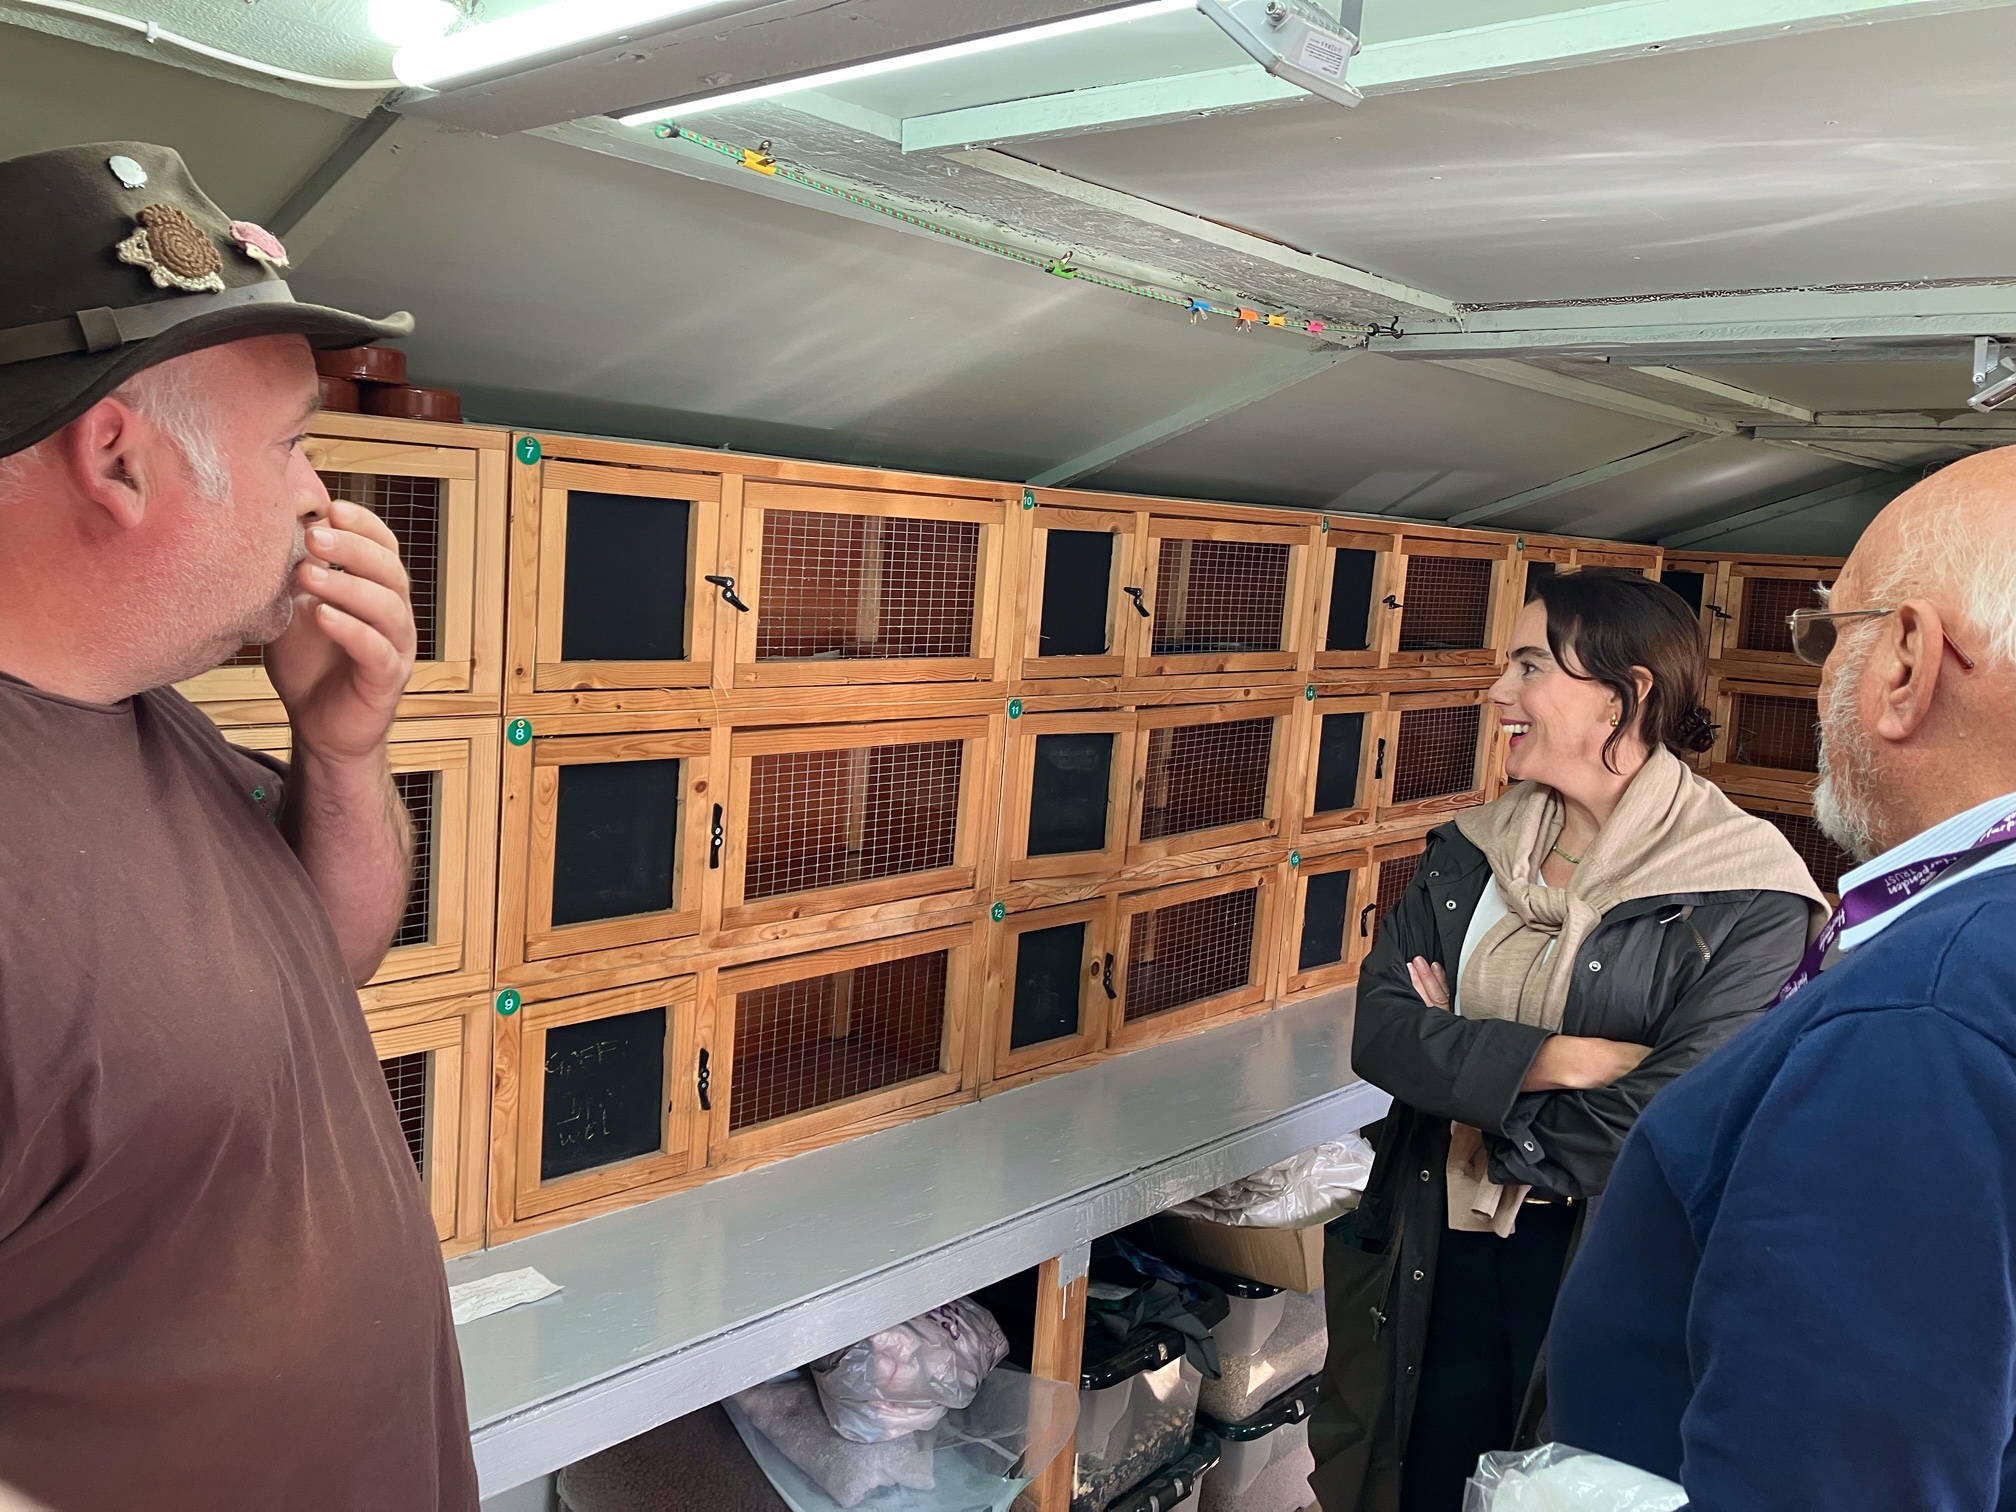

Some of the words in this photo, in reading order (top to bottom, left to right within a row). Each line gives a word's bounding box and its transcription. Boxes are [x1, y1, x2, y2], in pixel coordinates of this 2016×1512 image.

[525, 446, 534, 459] 7
[1023, 496, 1032, 506] 10
[1011, 705, 1019, 715] 11
[515, 728, 525, 740] 8
[1884, 868, 1917, 887] TRUST
[994, 908, 1003, 918] 12
[504, 998, 514, 1010] 9
